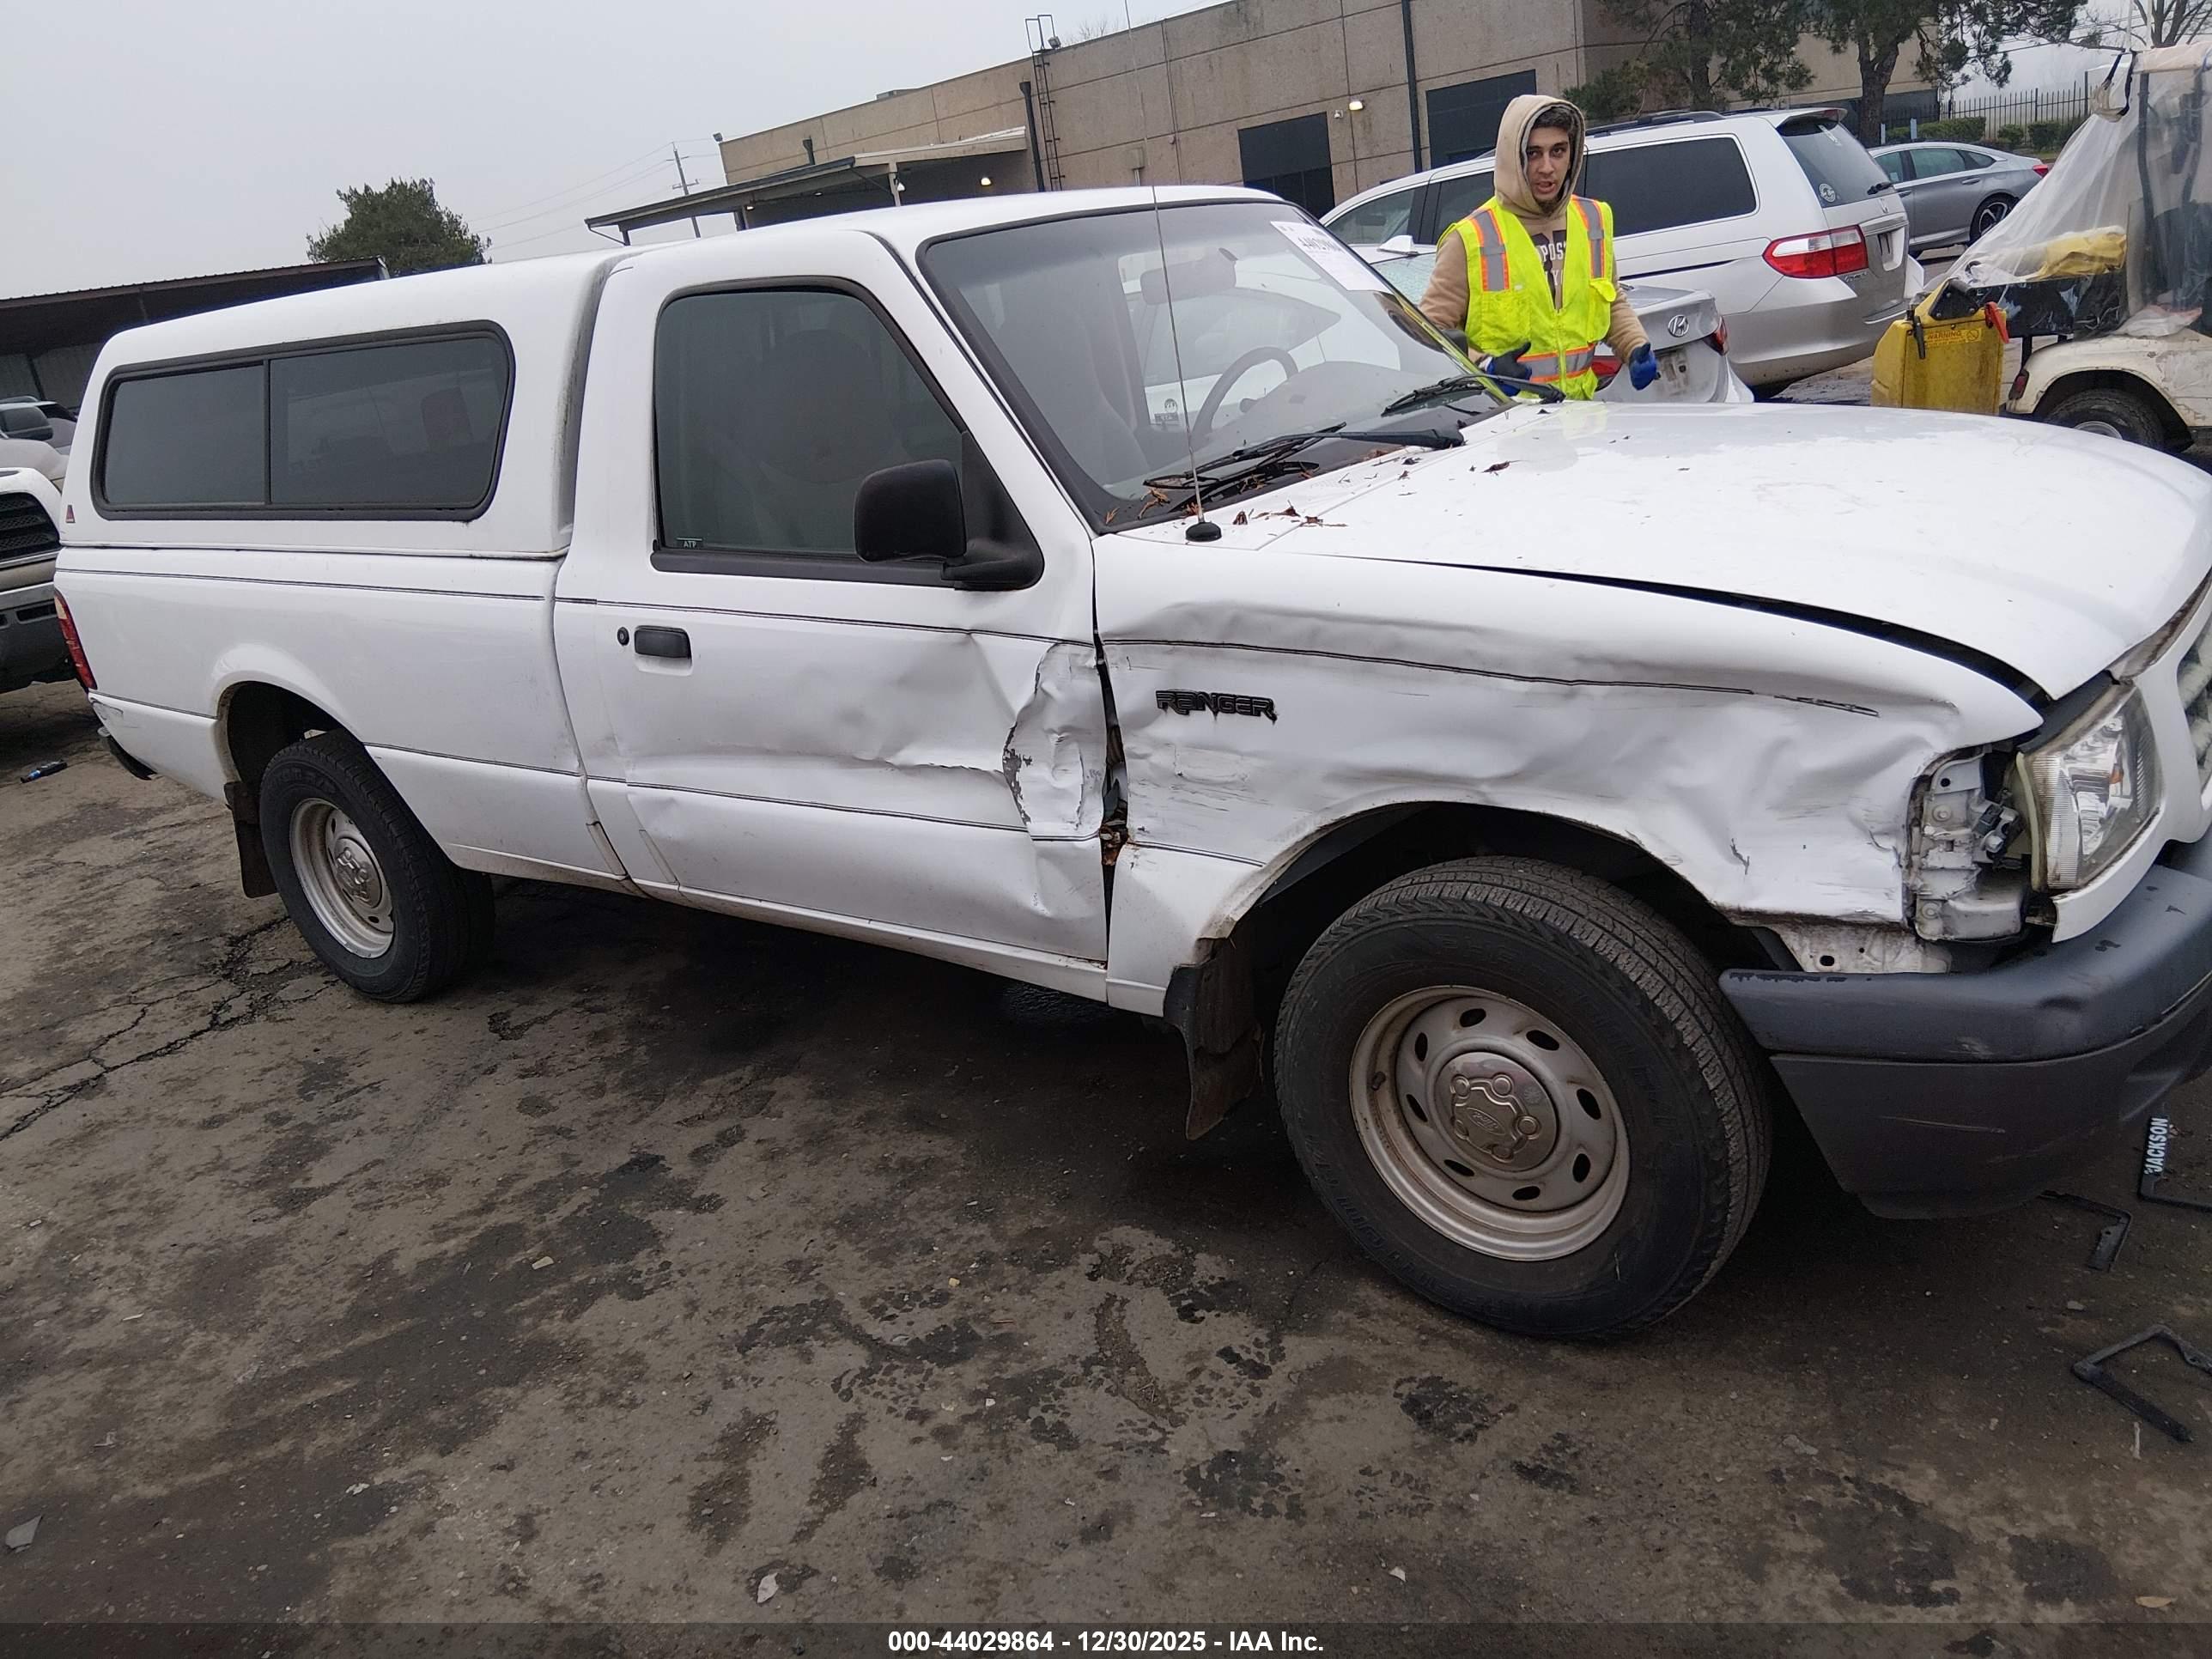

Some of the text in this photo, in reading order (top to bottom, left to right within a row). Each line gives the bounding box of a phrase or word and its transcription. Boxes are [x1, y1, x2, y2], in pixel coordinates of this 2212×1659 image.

[1540, 241, 1567, 263] POS
[1155, 689, 1278, 723] RANGER
[2145, 1117, 2168, 1173] JACKSON
